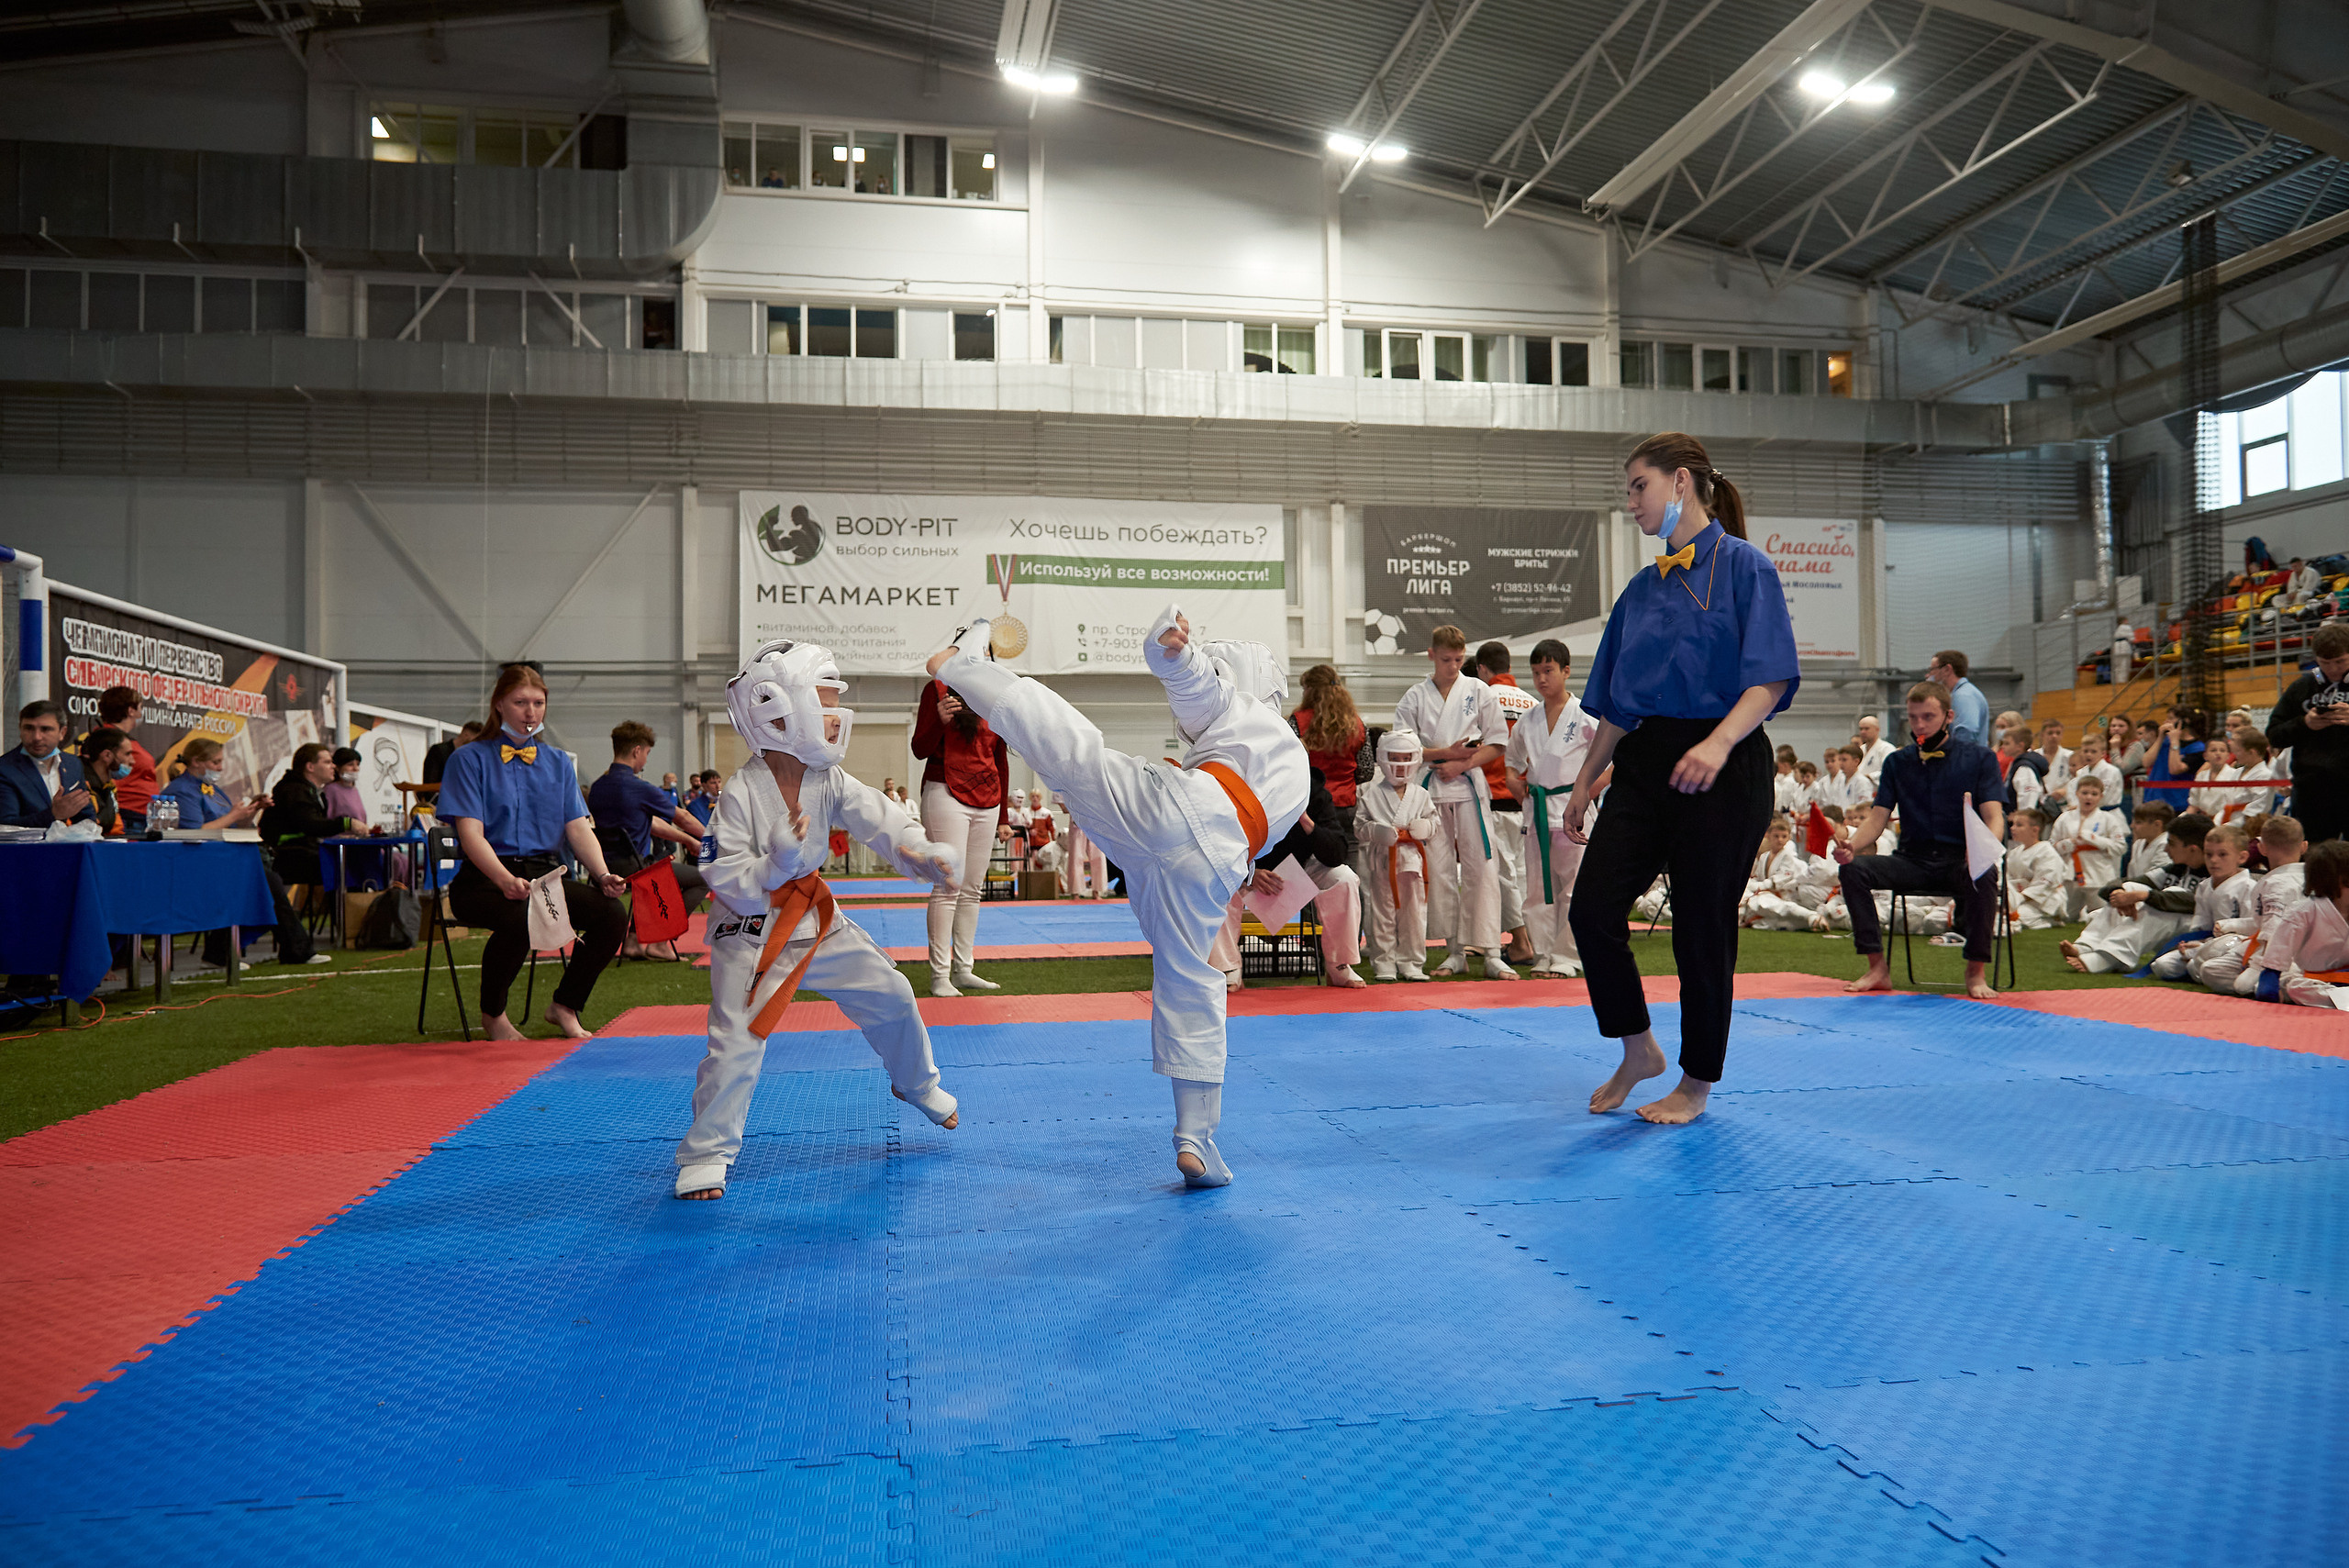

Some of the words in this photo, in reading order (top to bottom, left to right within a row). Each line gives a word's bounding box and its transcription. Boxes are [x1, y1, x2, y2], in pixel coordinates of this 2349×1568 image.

[836, 517, 959, 537] BODY-PIT
[1009, 518, 1109, 541] Хочешь
[1118, 523, 1268, 546] побеждать?
[1399, 533, 1457, 548] БАРБЕРШОП
[1765, 533, 1855, 558] Спасибо,
[836, 544, 888, 557] выбор
[892, 545, 959, 556] сильных
[1487, 548, 1533, 558] МУЖСКИЕ
[1534, 549, 1578, 558] СТРИЖКИ
[1386, 558, 1470, 576] ПРЕМЬЕР
[1514, 559, 1549, 568] БРИТЬЕ
[1019, 561, 1112, 581] Используй
[1117, 568, 1145, 580] все
[1151, 568, 1270, 582] возможности!
[1406, 578, 1453, 595] ЛИГА
[1503, 582, 1531, 593] (3852)
[1533, 583, 1572, 593] 52-96-42
[756, 584, 960, 606] МЕГАМАРКЕТ
[840, 626, 897, 635] добавок
[1092, 626, 1112, 636] пр.
[63, 617, 144, 665] ЧЕМПИОНАТ
[145, 637, 157, 669] И
[158, 639, 224, 682] ПЕРВЕНСТВО
[852, 639, 907, 647] питания
[887, 651, 931, 662] сладос
[1094, 652, 1146, 664] @bodyp
[65, 656, 151, 700] СИБИРСКОГО
[151, 671, 232, 713] ФЕДЕРАЛЬНОГО
[232, 689, 269, 719] ОКРУГА
[1499, 696, 1539, 709] RUSSI
[68, 695, 102, 716] СОЮ
[204, 717, 237, 734] РОССИИ
